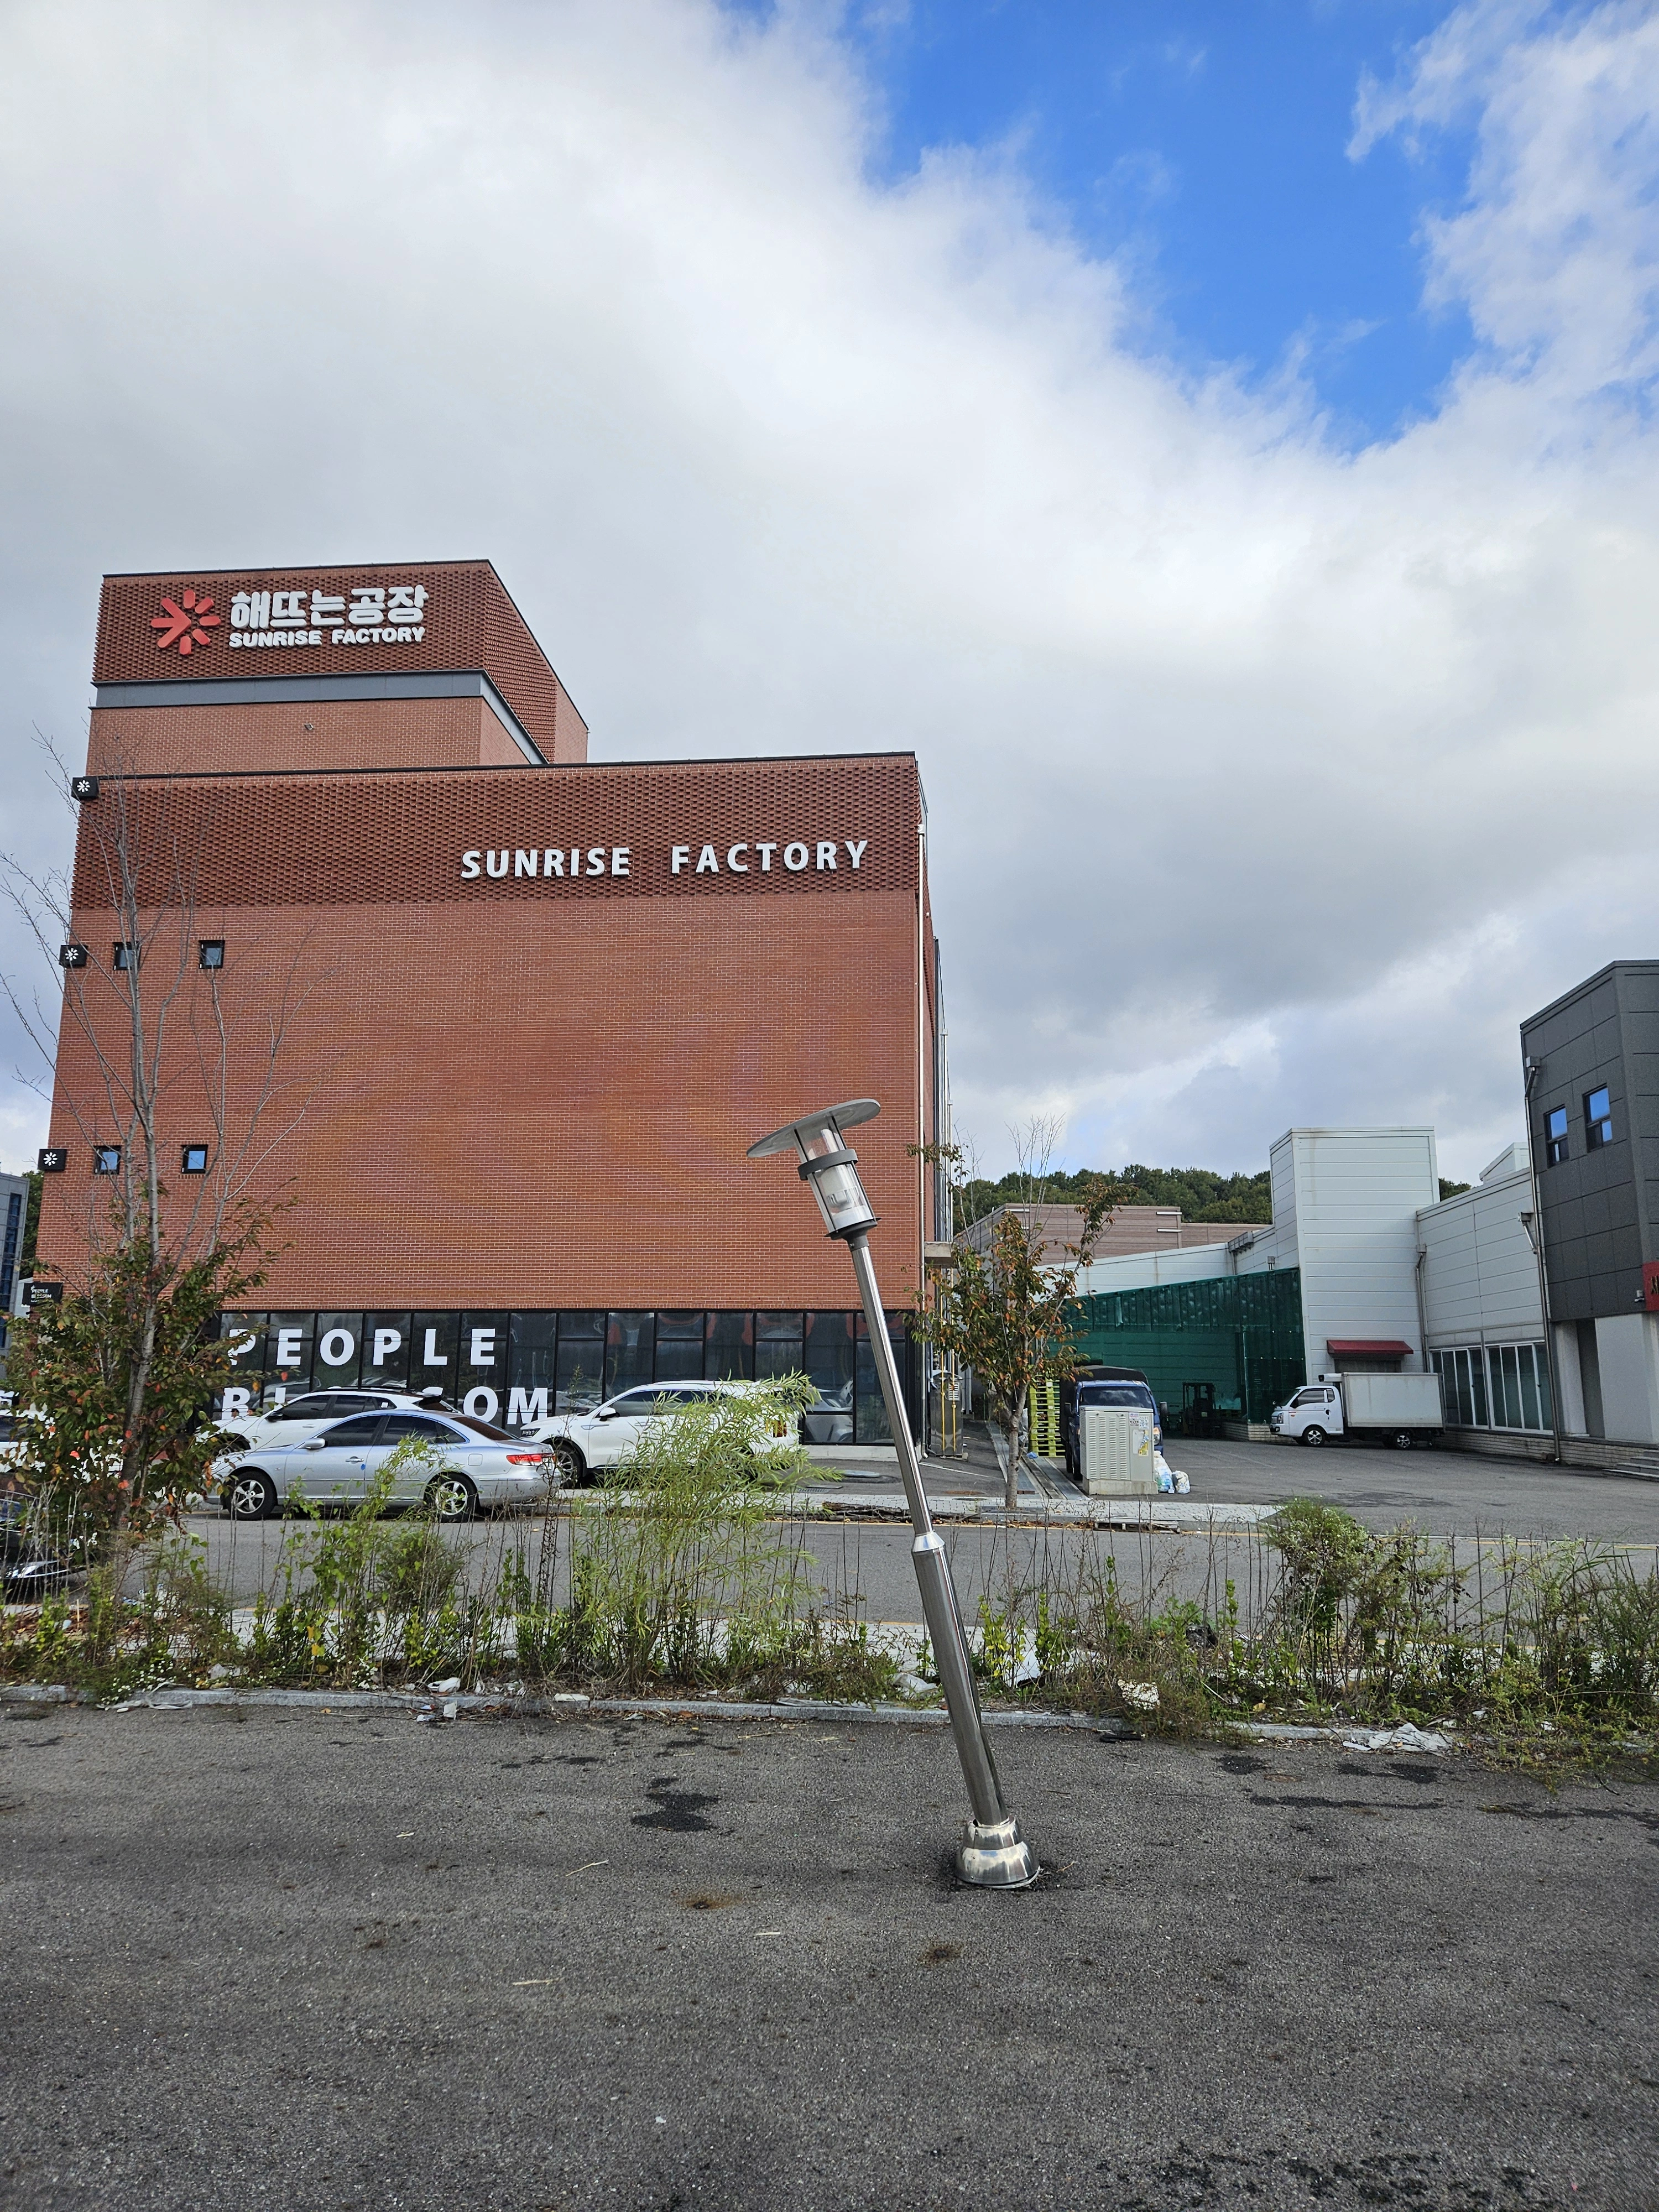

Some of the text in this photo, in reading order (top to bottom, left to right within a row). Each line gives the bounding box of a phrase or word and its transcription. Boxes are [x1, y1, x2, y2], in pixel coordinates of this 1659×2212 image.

[231, 585, 429, 630] 해뜨는공장
[228, 626, 426, 649] SUNRISE FACTORY
[460, 839, 869, 879] SUNRISE FACTORY
[227, 1328, 496, 1366] PEOPLE
